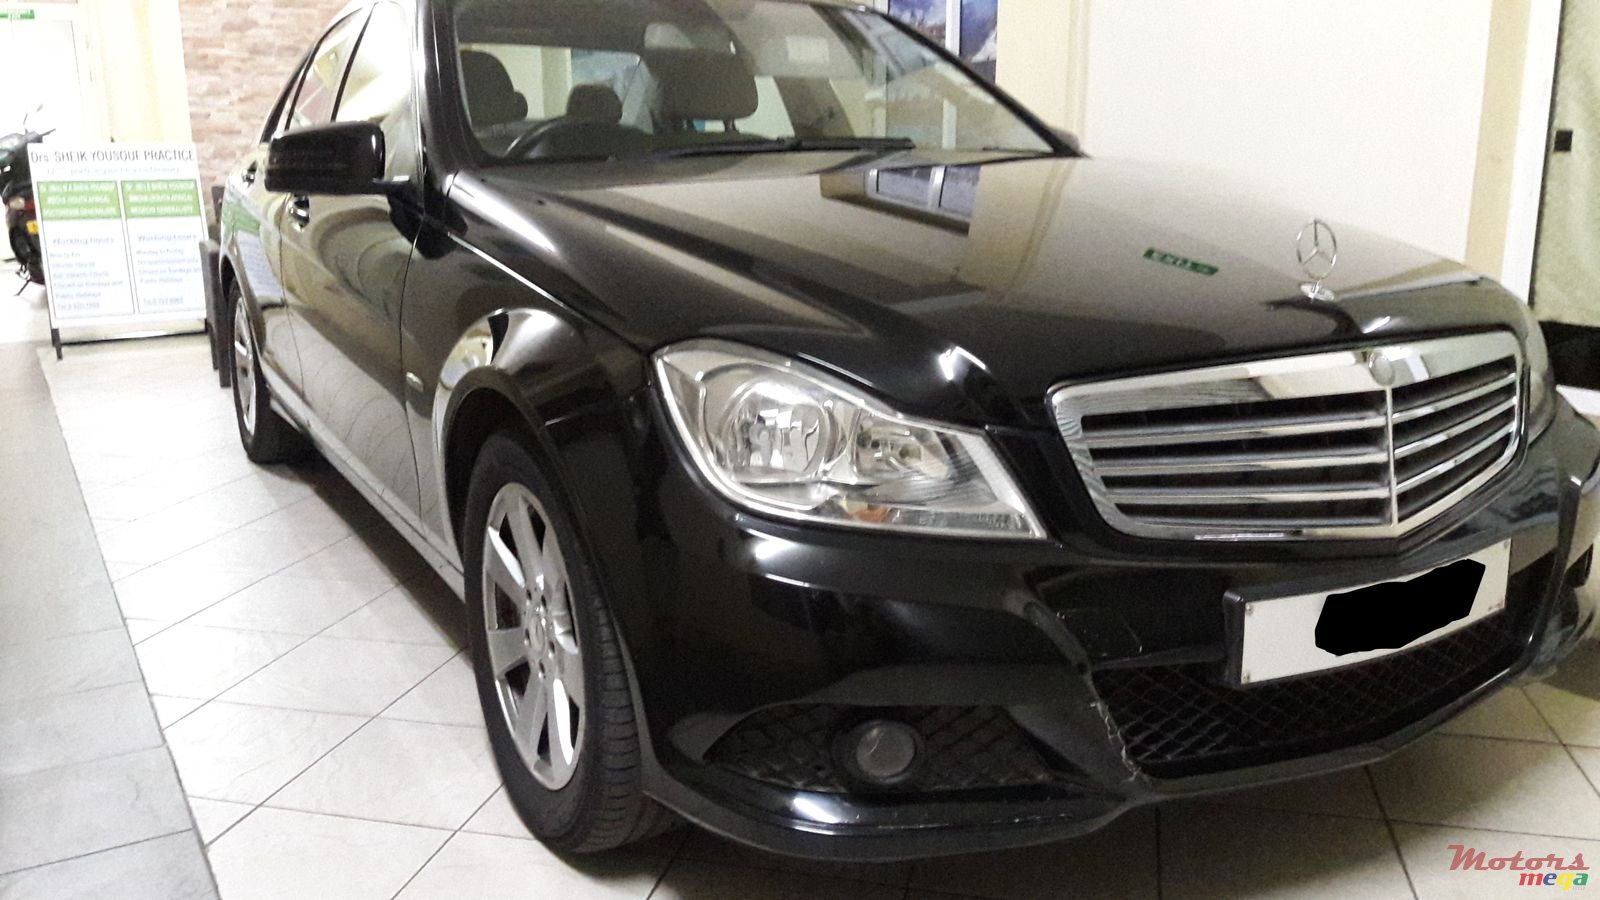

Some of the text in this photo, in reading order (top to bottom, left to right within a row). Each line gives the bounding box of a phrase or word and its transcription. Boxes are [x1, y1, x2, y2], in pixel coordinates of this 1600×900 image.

[55, 150, 88, 163] SHEIK
[91, 150, 140, 163] YOUSOUF
[144, 149, 194, 162] PRACTICE
